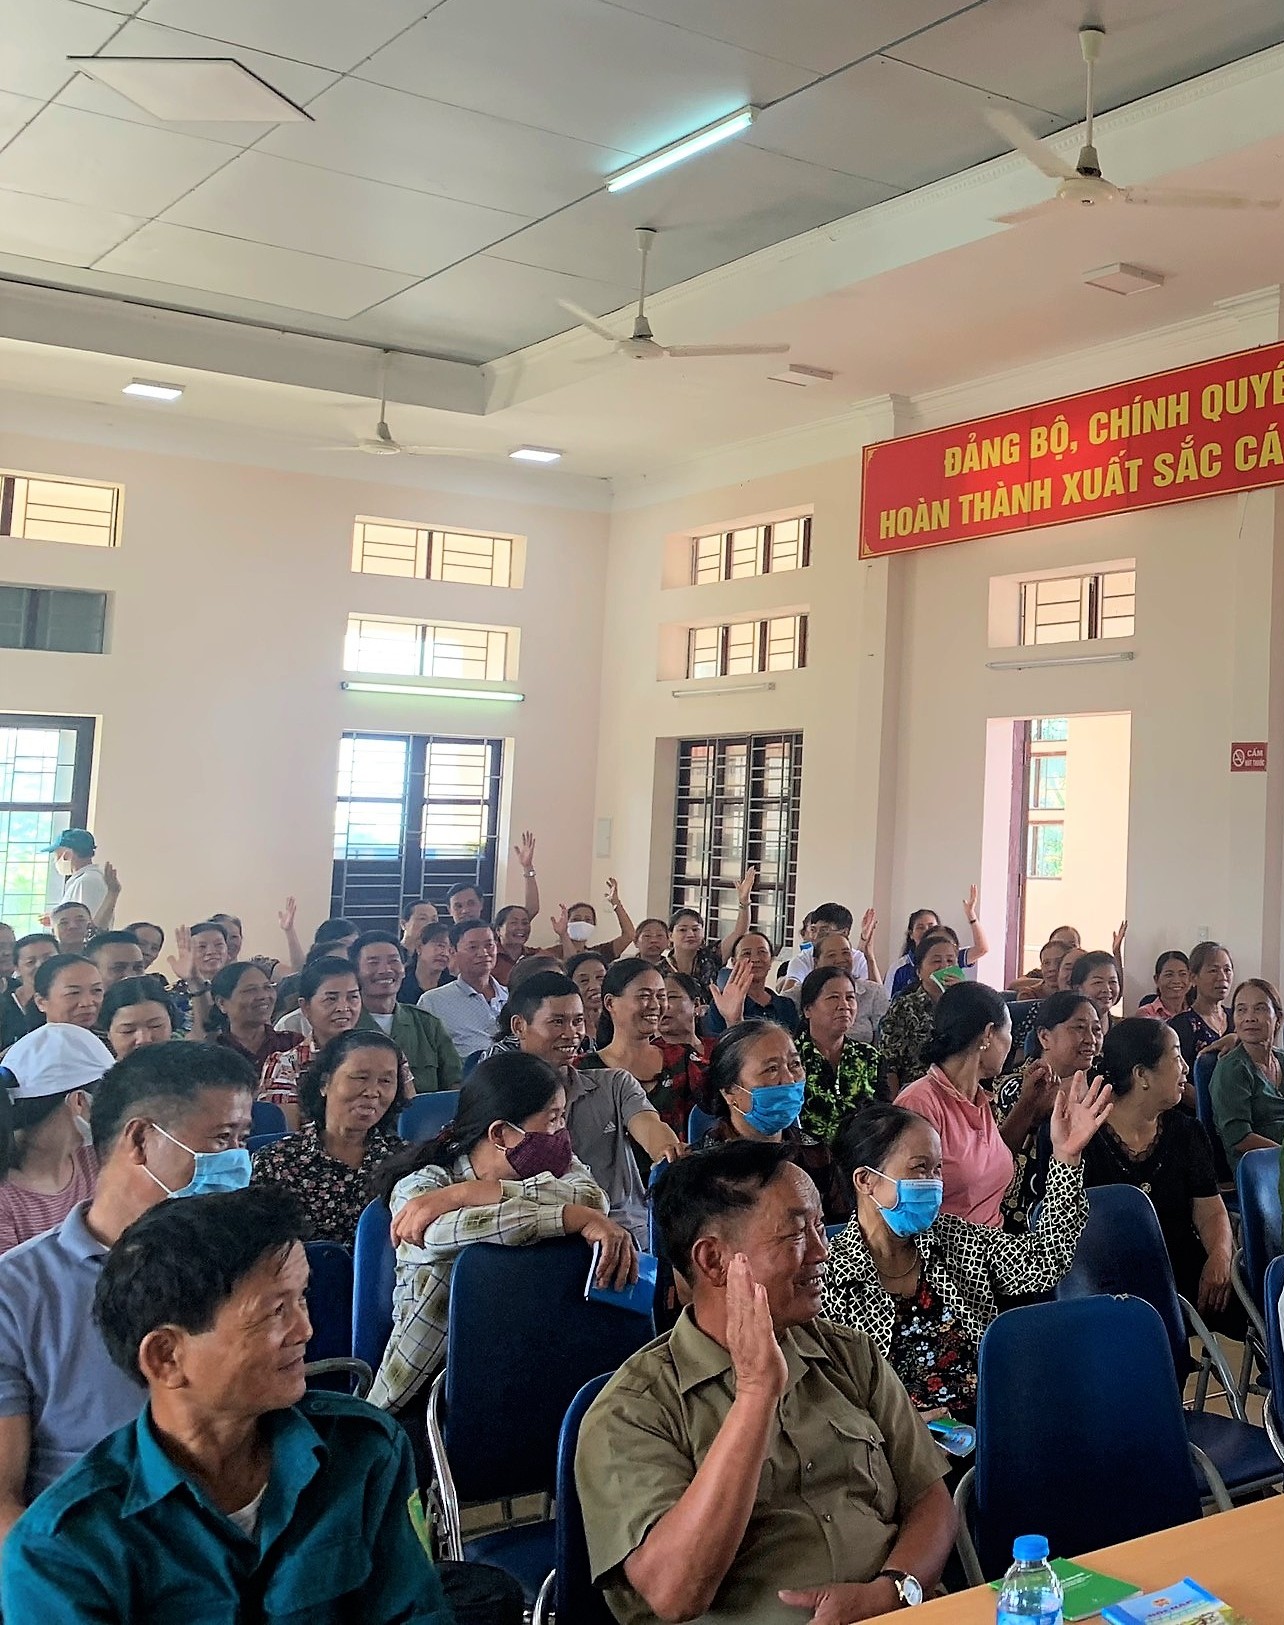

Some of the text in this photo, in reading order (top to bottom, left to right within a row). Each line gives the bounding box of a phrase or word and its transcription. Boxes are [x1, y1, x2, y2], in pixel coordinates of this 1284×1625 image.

[943, 433, 1020, 479] ĐẢNG
[1030, 415, 1079, 463] BỘ,
[1088, 391, 1189, 446] CHÍNH
[879, 494, 950, 540] HOÀN
[959, 478, 1052, 525] THÀNH
[1061, 456, 1143, 502] XUẤT
[1153, 435, 1222, 488] SẮC
